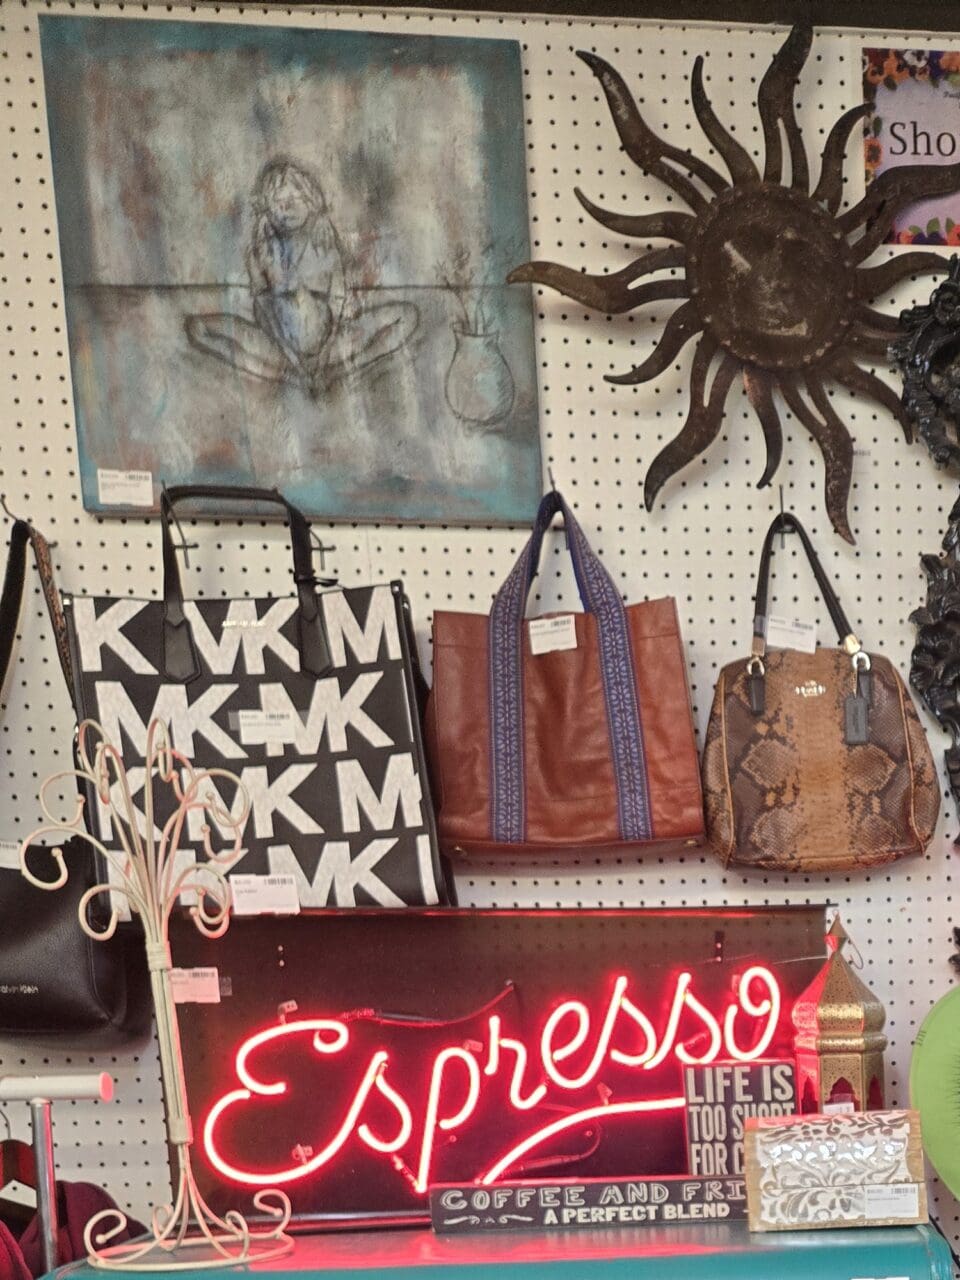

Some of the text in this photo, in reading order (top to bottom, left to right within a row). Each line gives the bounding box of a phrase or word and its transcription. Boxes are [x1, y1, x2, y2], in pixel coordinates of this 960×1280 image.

[204, 966, 781, 1192] Espresso
[686, 1065, 794, 1103] LIFE IS
[689, 1104, 727, 1142] TOO
[691, 1143, 727, 1176] FOR
[441, 1185, 586, 1210] COFFEE
[600, 1181, 670, 1204] AND
[544, 1202, 731, 1225] A PERFECT BLEND
